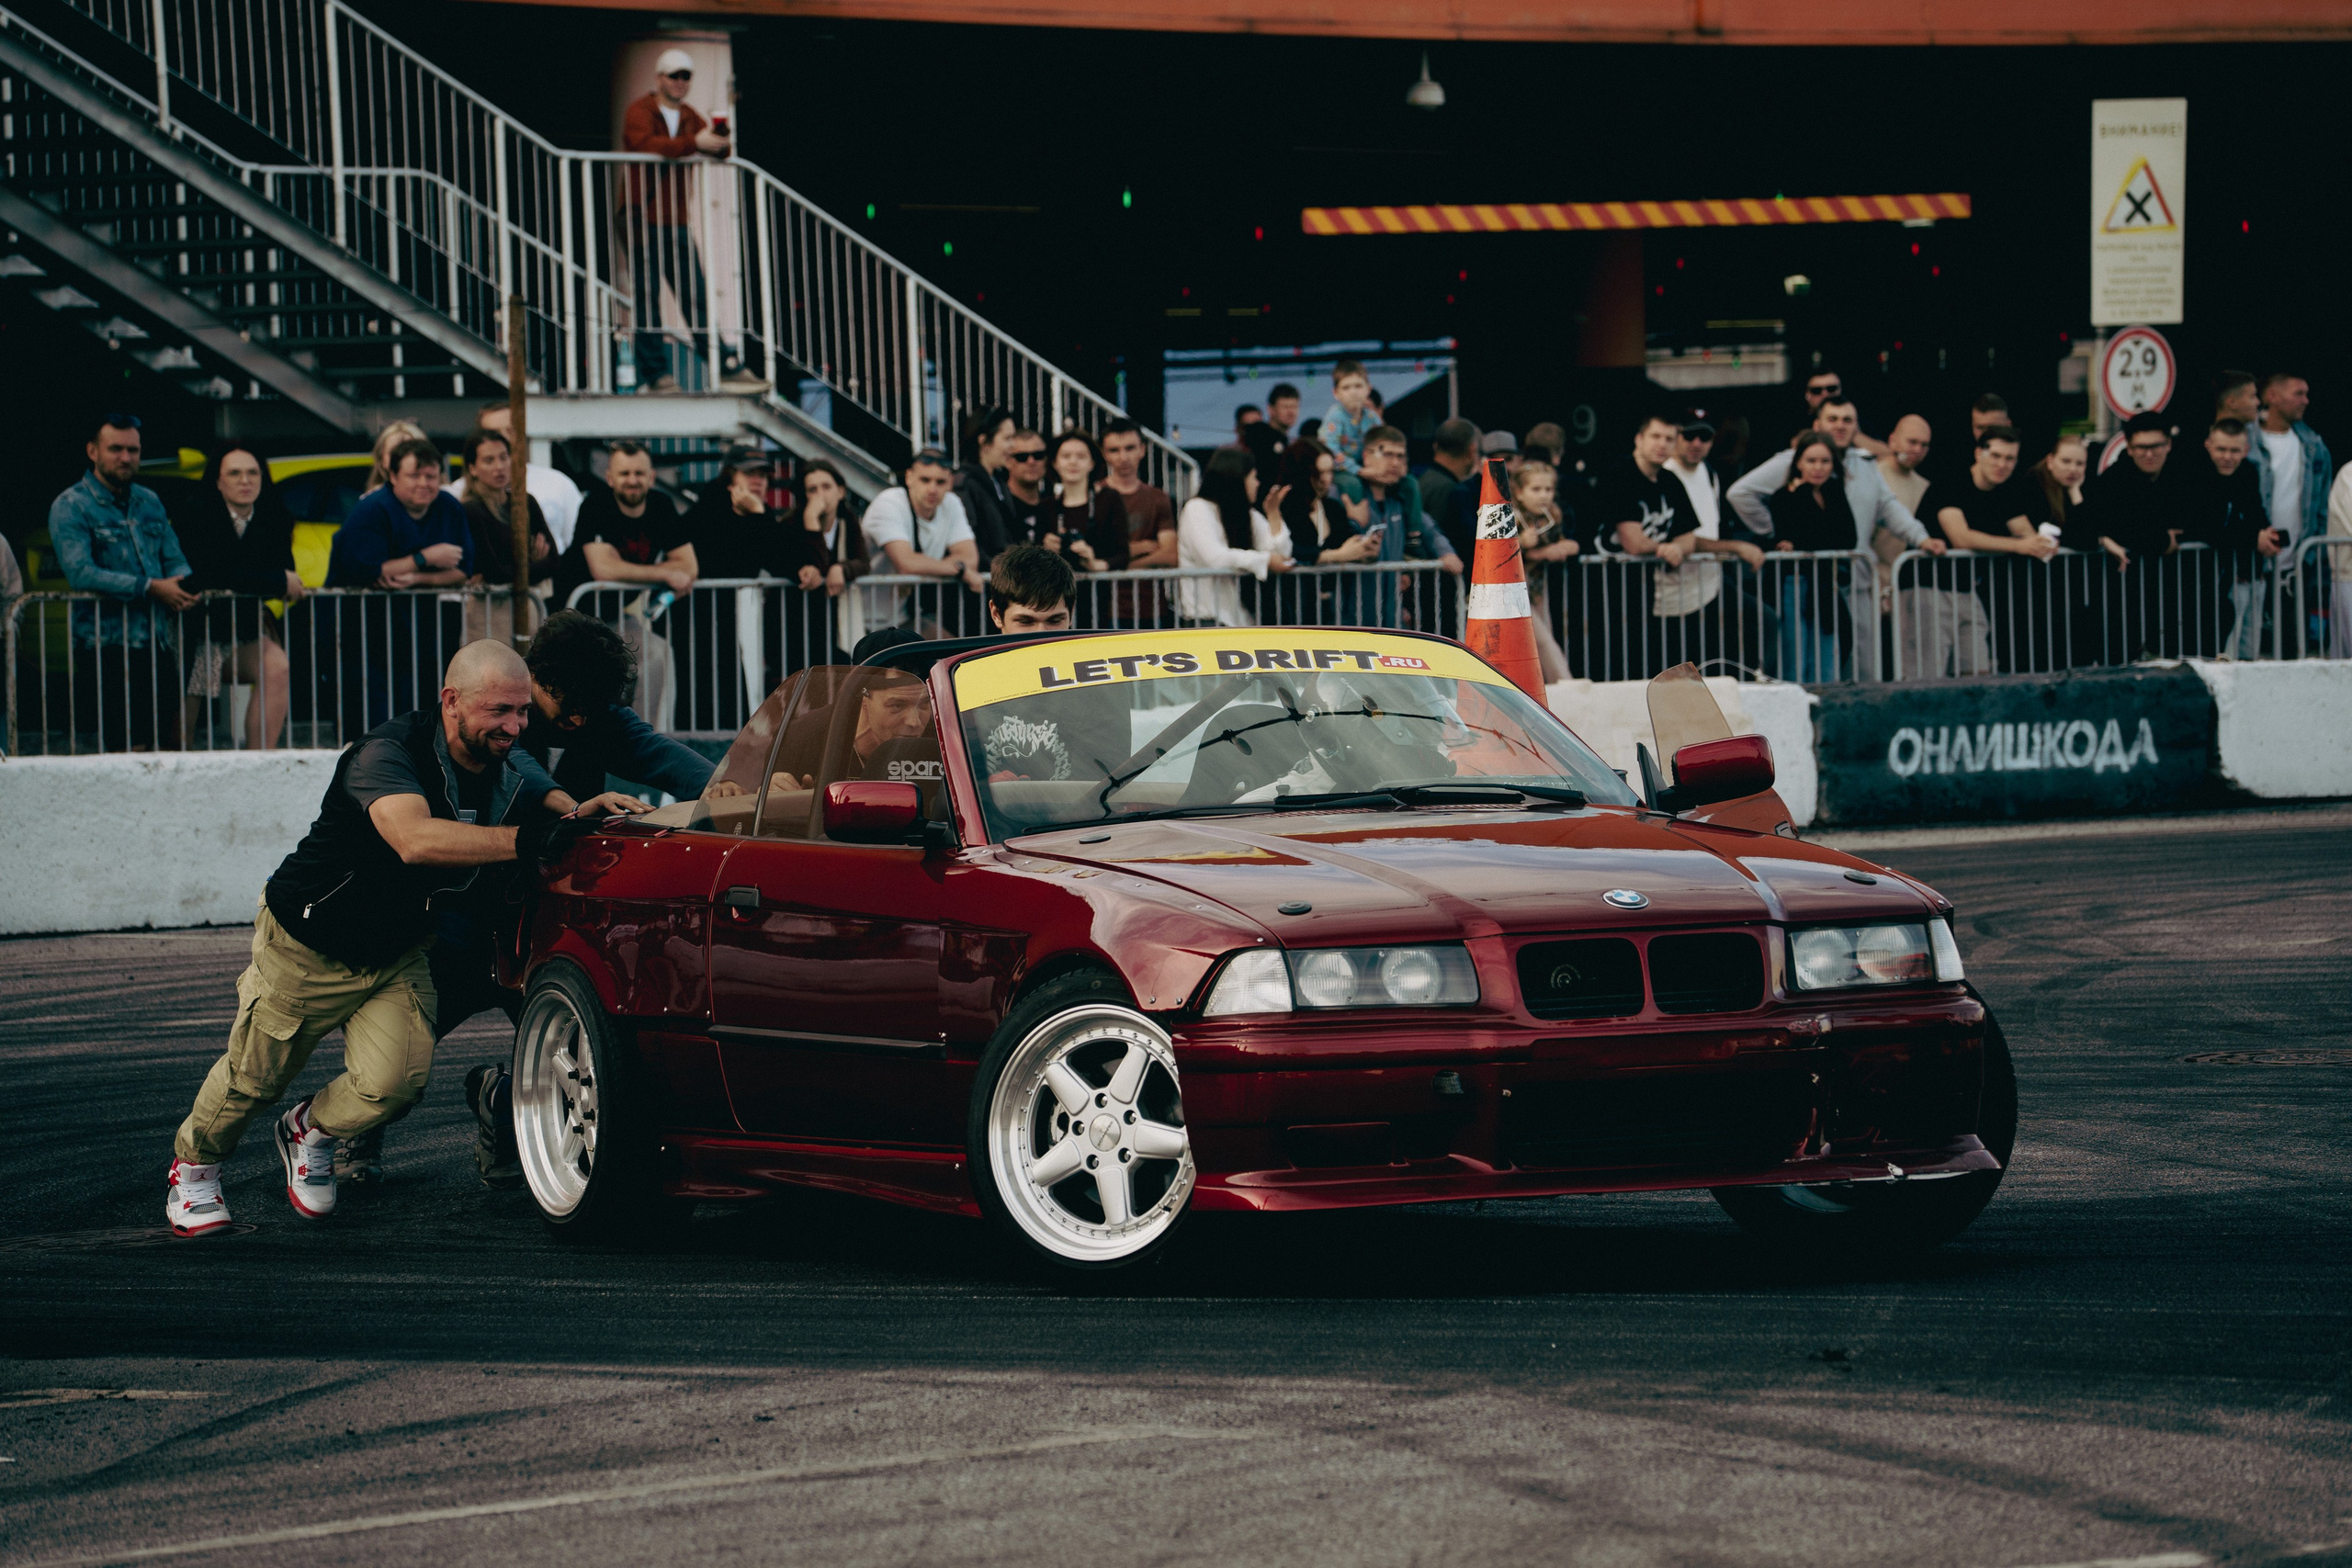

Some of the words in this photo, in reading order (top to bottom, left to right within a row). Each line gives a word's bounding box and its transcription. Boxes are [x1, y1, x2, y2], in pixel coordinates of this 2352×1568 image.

[1572, 404, 1596, 445] 9
[1039, 652, 1200, 688] LET'S
[1216, 649, 1382, 671] DRIFT
